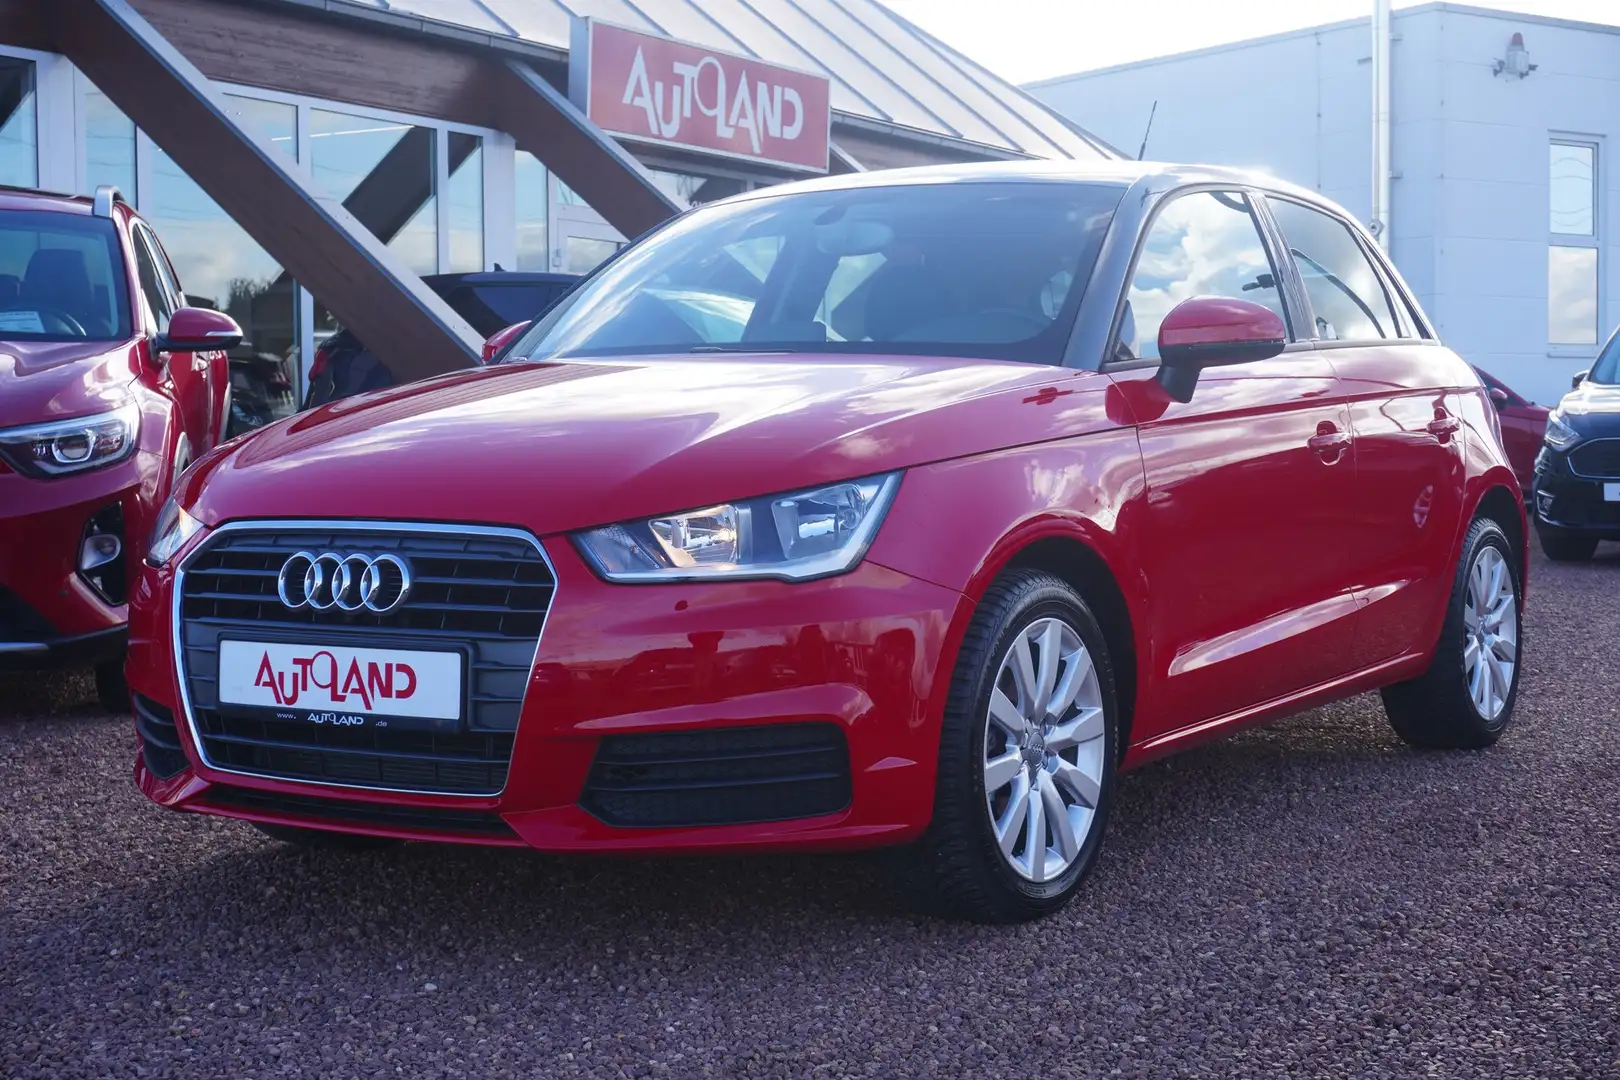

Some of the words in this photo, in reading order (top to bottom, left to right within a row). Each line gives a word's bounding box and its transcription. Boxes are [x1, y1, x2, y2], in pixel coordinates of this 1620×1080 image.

[622, 44, 804, 154] AUTOLAND
[254, 650, 417, 711] AUTOLAND
[307, 712, 364, 726] AUTOLAND
